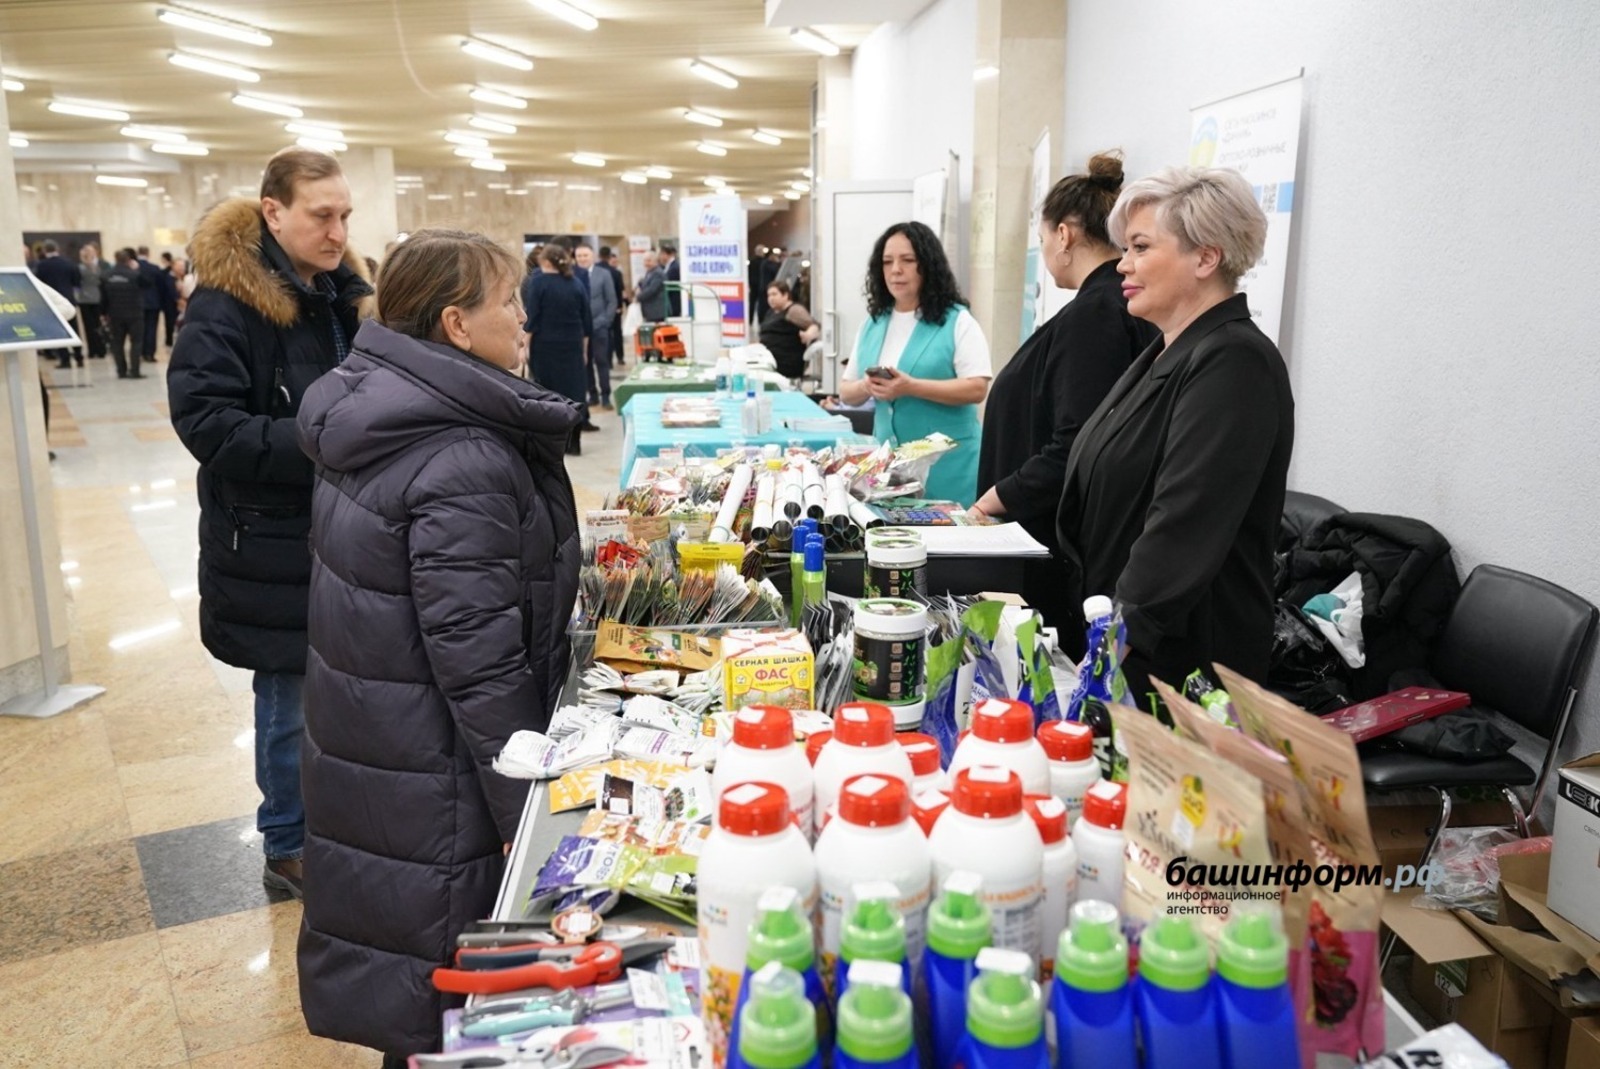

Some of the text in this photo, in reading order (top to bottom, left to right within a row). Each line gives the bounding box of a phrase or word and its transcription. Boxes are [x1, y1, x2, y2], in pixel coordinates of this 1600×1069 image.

[734, 655, 808, 668] СЕРНАЯ ШАШКА
[754, 667, 789, 681] ФАС
